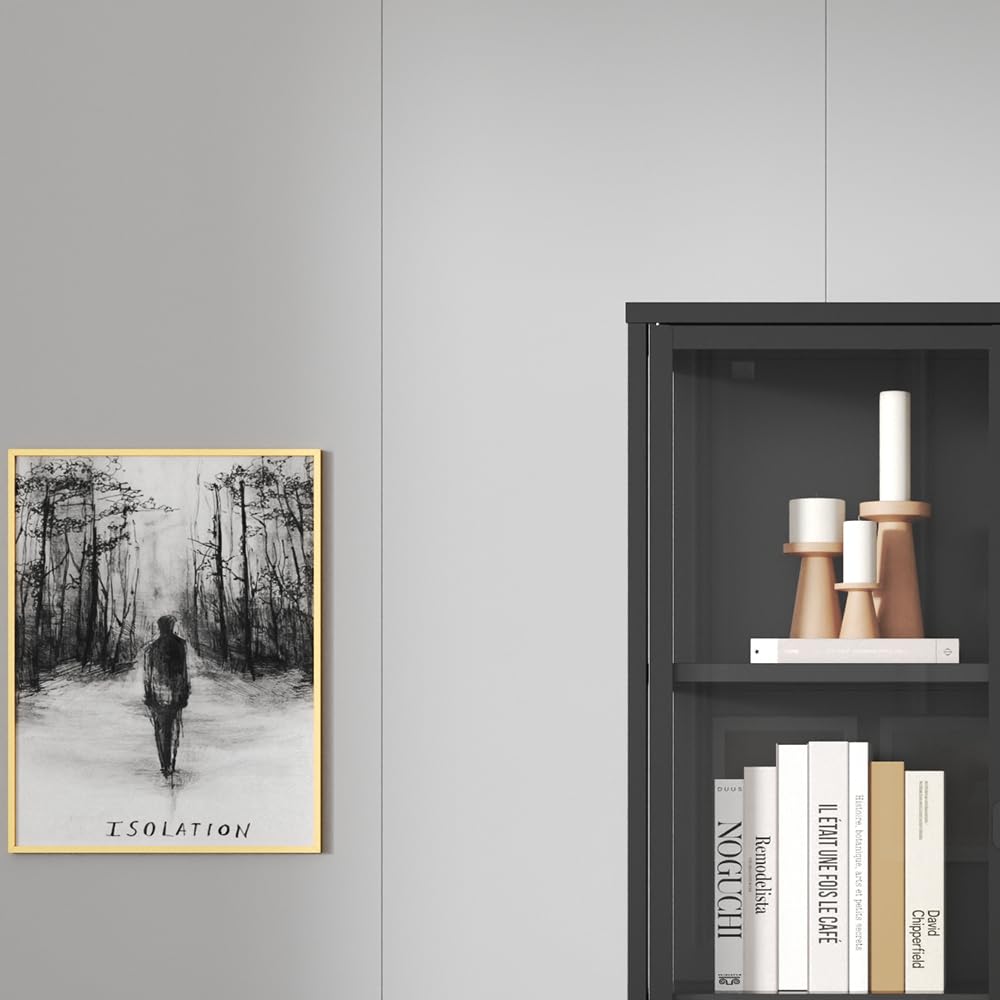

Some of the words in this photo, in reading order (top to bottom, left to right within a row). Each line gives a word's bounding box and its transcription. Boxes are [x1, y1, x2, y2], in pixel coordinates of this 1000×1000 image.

[818, 804, 838, 814] IL
[105, 819, 252, 839] ISOLATION
[818, 816, 842, 847] ÉTAIT
[818, 849, 838, 871] UNE
[717, 821, 743, 939] NOGUCHI
[755, 835, 772, 915] Remodelista
[818, 874, 838, 898] FOIS
[818, 900, 838, 914] LE
[818, 916, 842, 944] CAFÉ
[927, 909, 941, 937] David
[910, 909, 925, 969] Chipperfield
